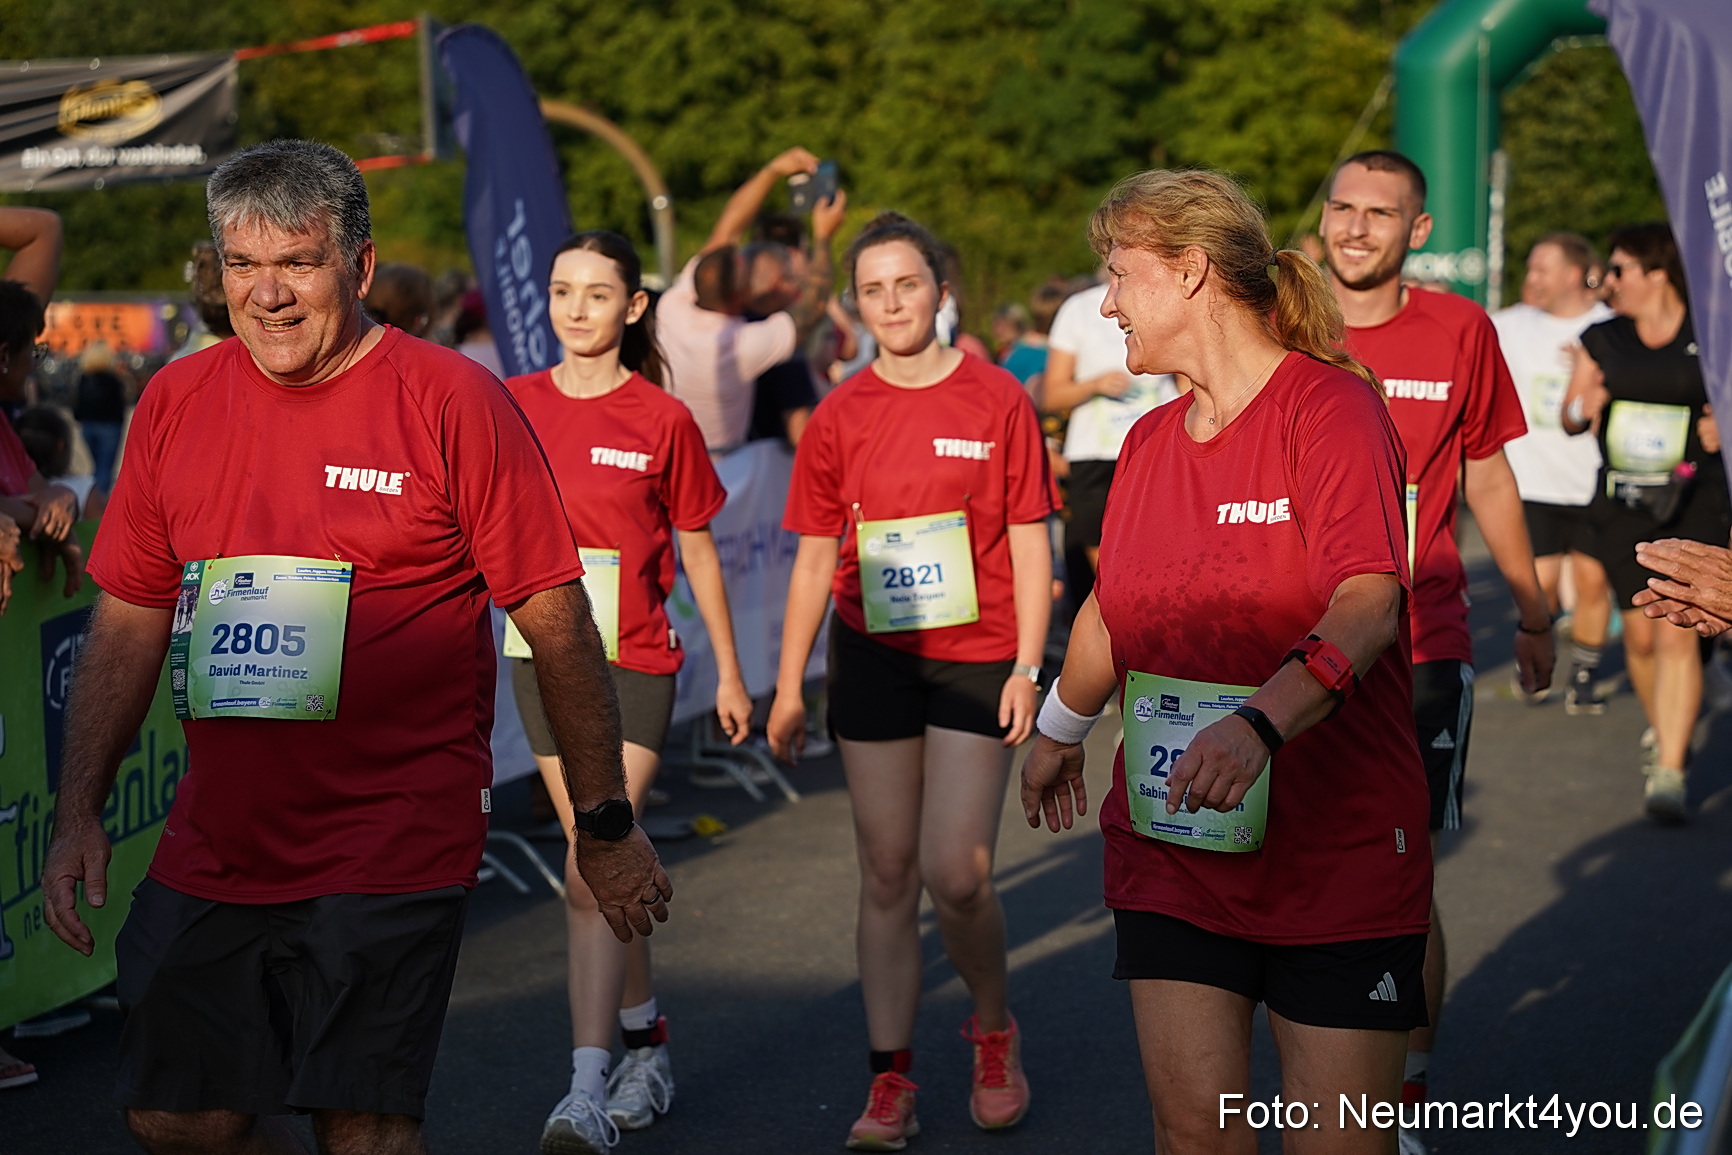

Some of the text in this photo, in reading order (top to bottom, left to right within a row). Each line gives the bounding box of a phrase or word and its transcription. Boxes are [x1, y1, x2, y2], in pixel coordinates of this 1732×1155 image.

[1384, 378, 1449, 401] THULE
[591, 447, 648, 472] THULE
[933, 438, 991, 461] THULE
[325, 465, 404, 495] THULE
[1217, 498, 1291, 524] THULE
[184, 571, 200, 581] AOK
[882, 563, 943, 589] 2821
[226, 586, 270, 598] Firmenlauf
[210, 622, 307, 657] 2805
[208, 663, 308, 679] David Martinez
[213, 700, 257, 708] firmenlauf.bayern
[1154, 709, 1195, 721] Firmenlauf
[1150, 745, 1186, 778] 28
[1139, 783, 1168, 800] Sabin
